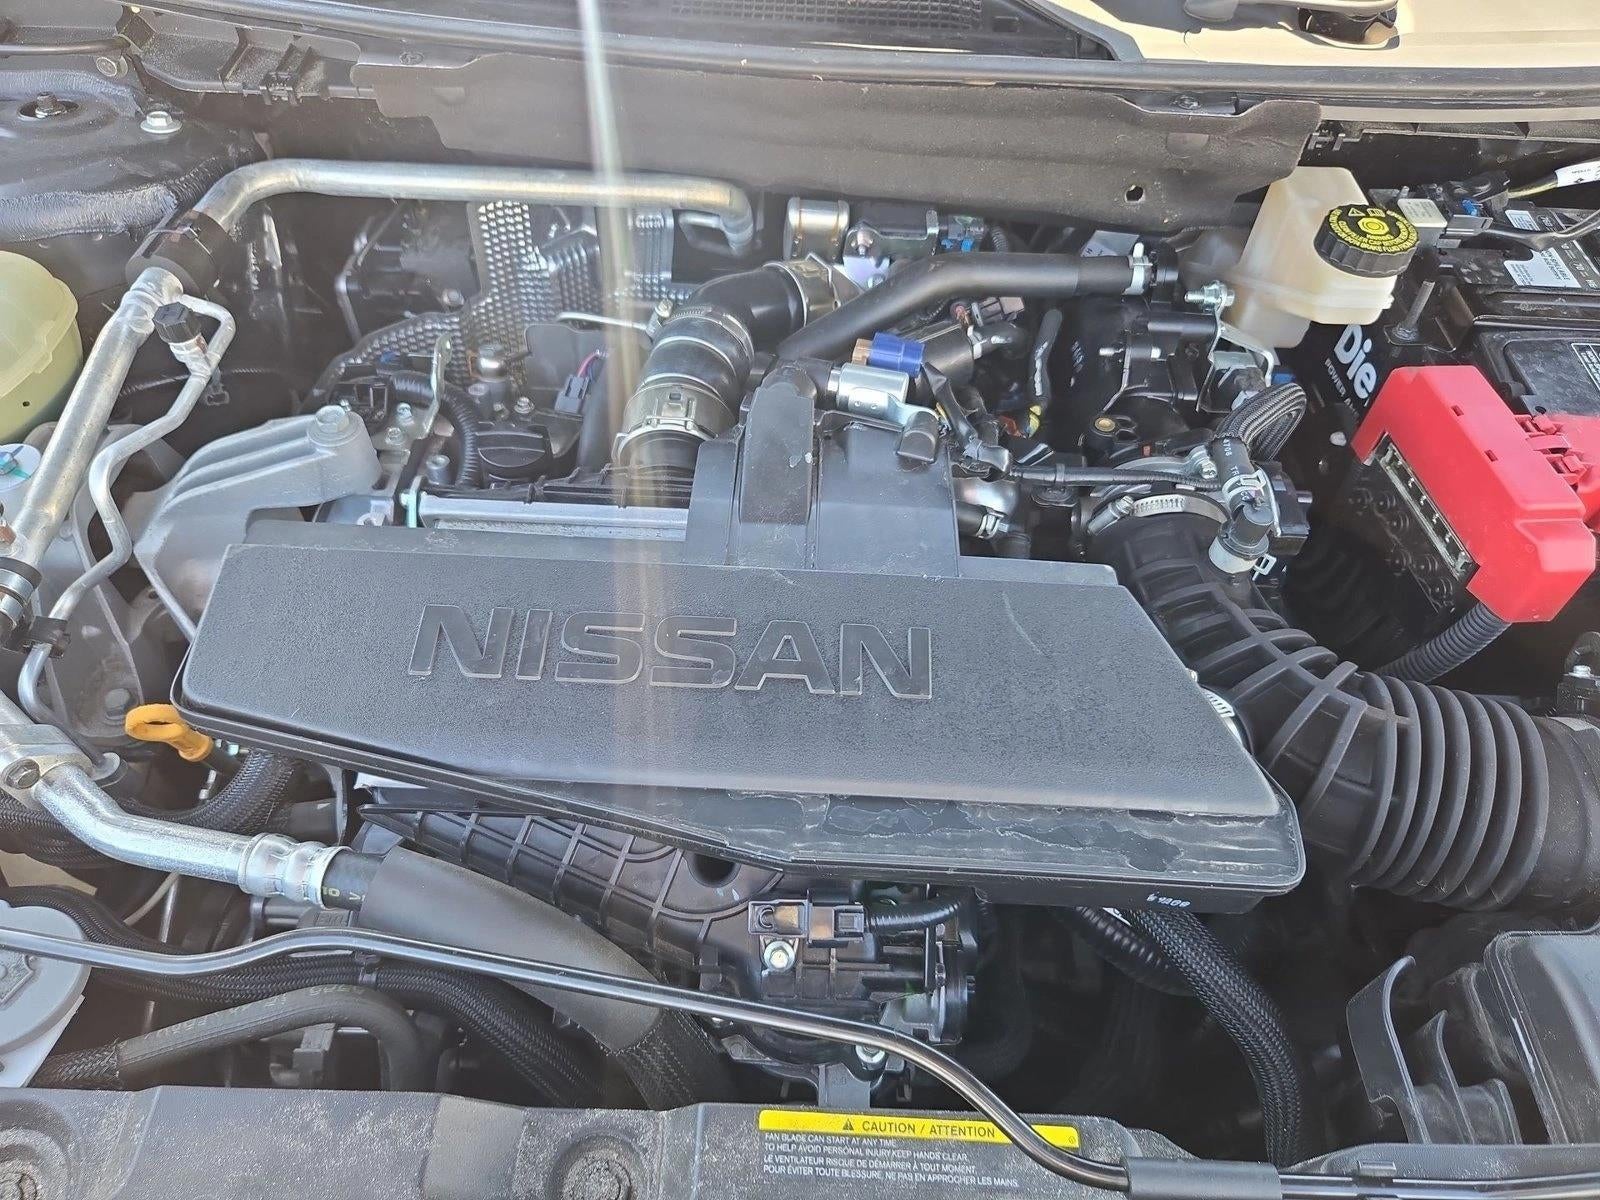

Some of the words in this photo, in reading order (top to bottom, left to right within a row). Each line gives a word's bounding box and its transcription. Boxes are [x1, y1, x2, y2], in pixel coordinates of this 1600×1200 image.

[408, 604, 933, 699] NISSAN
[862, 1121, 915, 1133] CAUTION
[929, 1124, 996, 1138] ATTENTION
[765, 1133, 780, 1142] FAN
[781, 1134, 807, 1143] BLADE
[808, 1135, 825, 1144] CAN
[826, 1135, 850, 1145] START
[851, 1137, 860, 1145] AT
[862, 1137, 877, 1146] ANY
[764, 1142, 775, 1151] TO
[777, 1143, 797, 1152] HELP
[798, 1144, 821, 1153] AVOID
[823, 1146, 864, 1156] PERSONAL
[913, 1151, 940, 1161] HANDS
[764, 1154, 774, 1163] LE
[774, 1155, 824, 1165] VENTILATEUR
[826, 1157, 855, 1168] RISQUE
[857, 1159, 867, 1168] DE
[920, 1162, 940, 1172] TOUT
[763, 1165, 786, 1174] POUR
[787, 1164, 813, 1175] ÉVITER
[815, 1167, 840, 1177] TOUTE
[885, 1171, 896, 1180] NE
[897, 1172, 913, 1181] PAS
[914, 1172, 925, 1182] EN
[927, 1173, 976, 1185] APPROCHER
[977, 1176, 992, 1186] LES
